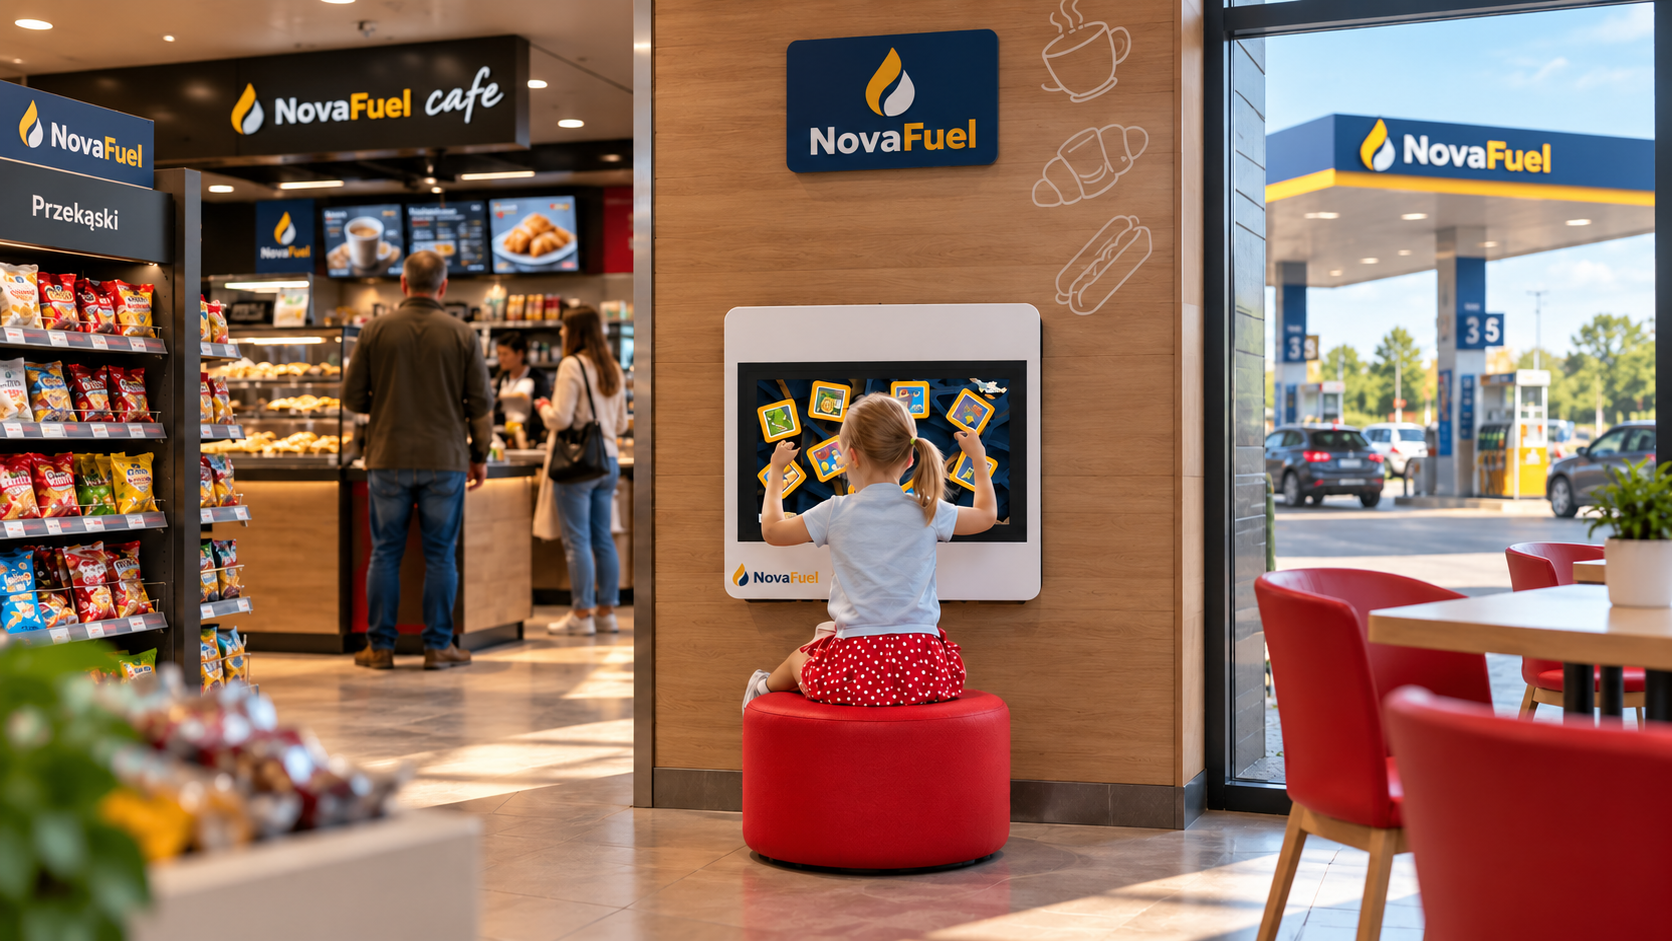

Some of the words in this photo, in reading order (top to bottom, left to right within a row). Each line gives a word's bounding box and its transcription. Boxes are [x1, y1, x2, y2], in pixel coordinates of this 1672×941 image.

[274, 88, 412, 125] NovaFuel
[424, 65, 504, 124] cafe
[51, 121, 143, 168] NovaFuel
[809, 118, 977, 156] NovaFuel
[1403, 133, 1551, 173] NovaFuel
[32, 194, 119, 231] Przekąski
[260, 246, 311, 260] NovaFuel
[1465, 316, 1480, 345] 3
[753, 571, 819, 584] NovaFuel
